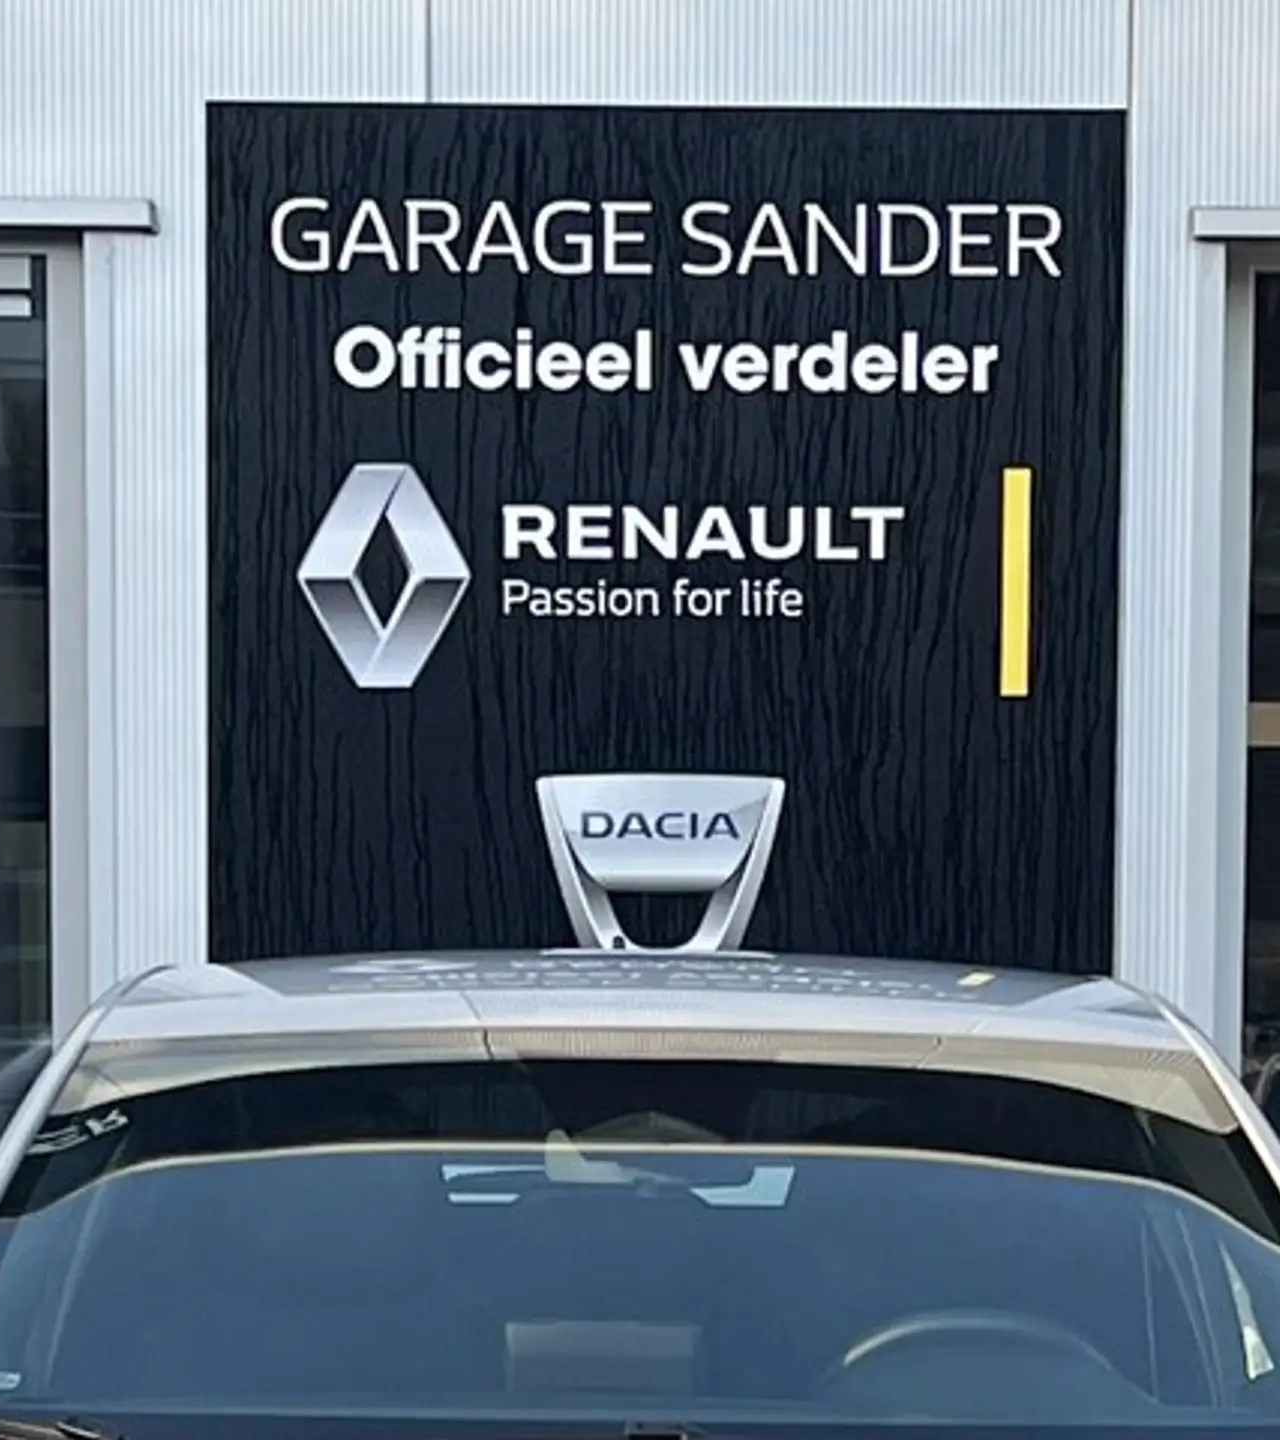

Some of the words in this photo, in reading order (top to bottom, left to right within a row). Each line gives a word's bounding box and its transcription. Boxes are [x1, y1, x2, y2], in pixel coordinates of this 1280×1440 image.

[272, 198, 652, 274] GARAGE
[682, 202, 1062, 277] SANDER
[334, 325, 652, 391] Officieel
[679, 331, 999, 394] verdeler
[502, 504, 905, 561] RENAULT
[502, 579, 660, 617] Passion
[673, 578, 731, 617] for
[741, 578, 803, 617] life
[581, 811, 740, 839] DACIA
